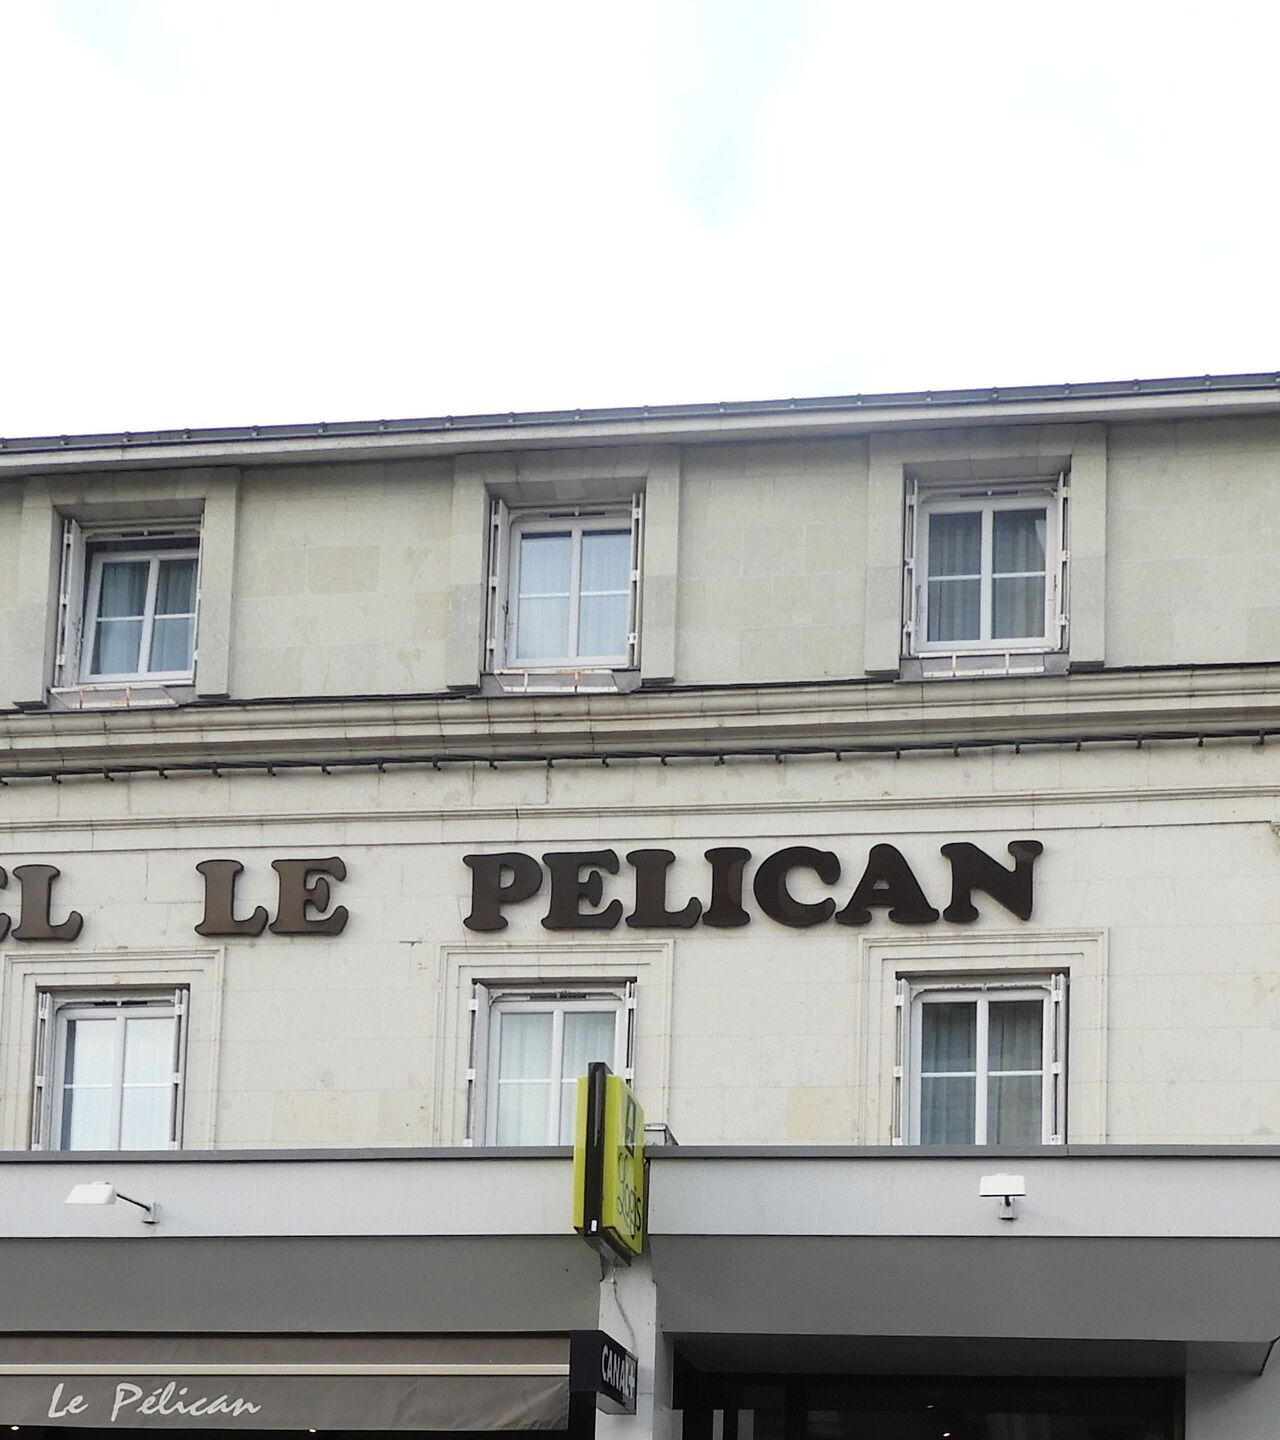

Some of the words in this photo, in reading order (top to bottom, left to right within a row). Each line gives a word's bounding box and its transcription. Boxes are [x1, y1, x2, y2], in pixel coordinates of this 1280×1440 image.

[195, 857, 349, 937] LE
[463, 840, 1043, 931] PELICAN
[48, 1383, 88, 1418] Le
[110, 1381, 262, 1422] Pélican
